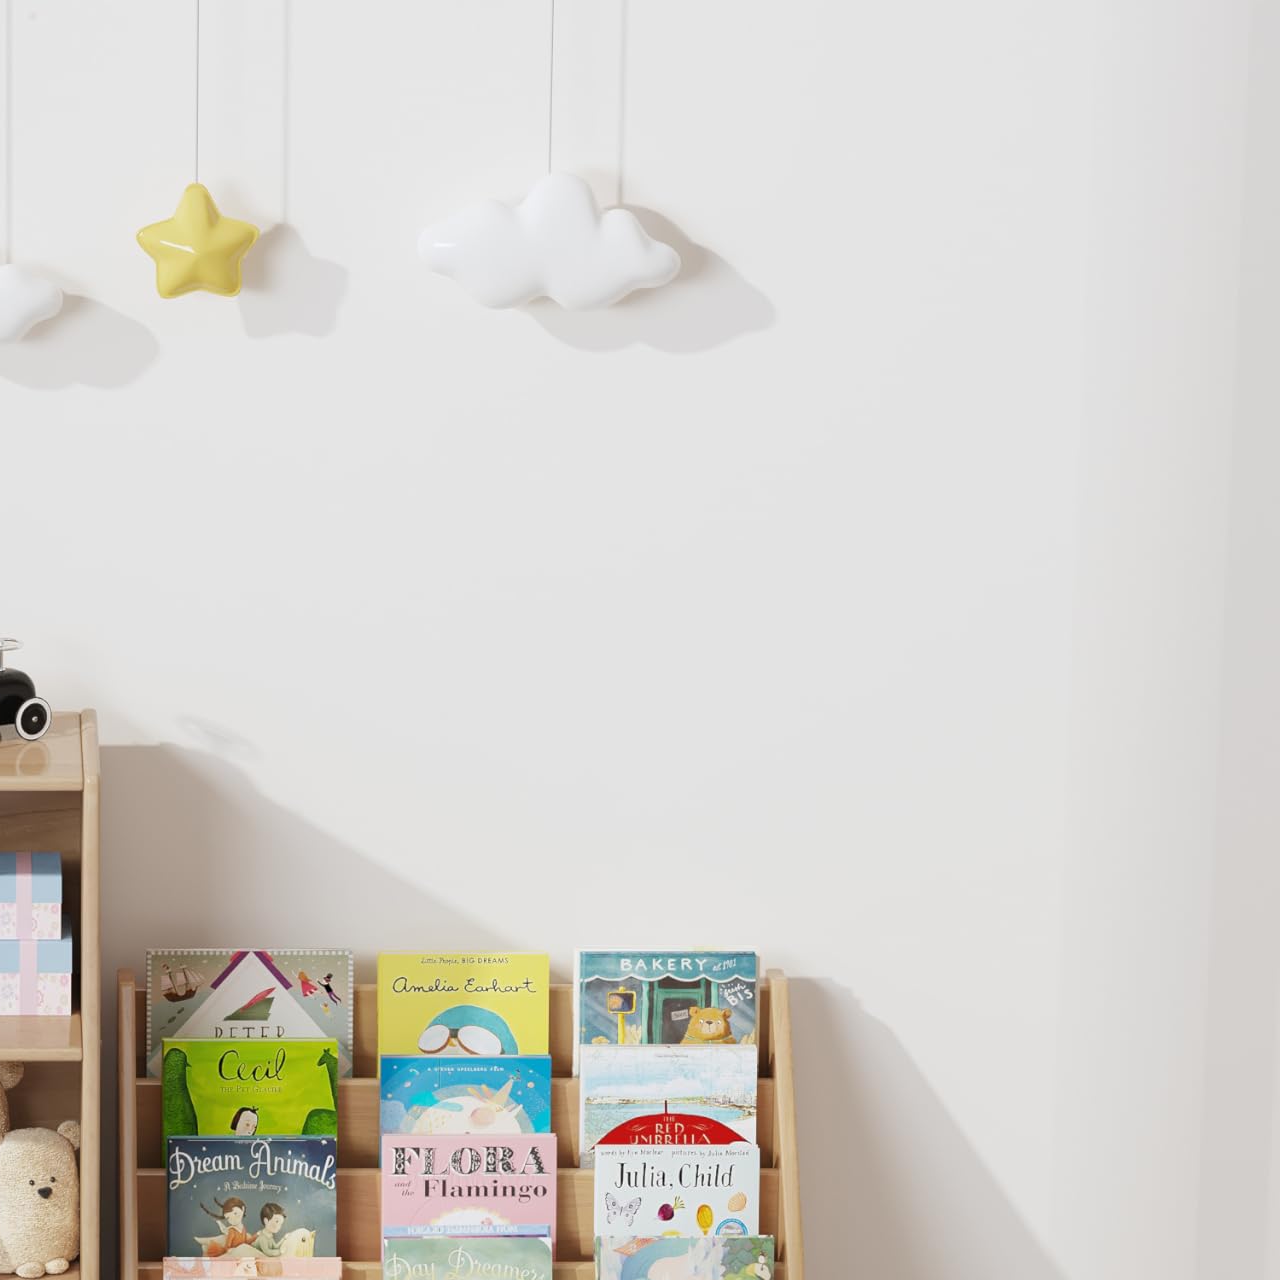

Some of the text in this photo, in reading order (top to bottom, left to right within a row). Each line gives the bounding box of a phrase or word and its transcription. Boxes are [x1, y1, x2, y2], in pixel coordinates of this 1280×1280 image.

[620, 958, 708, 971] BAKERY
[392, 976, 537, 993] Amelia Earhart
[218, 1048, 286, 1081] Cecil
[655, 1123, 685, 1134] RED
[169, 1138, 337, 1190] Dream Animals
[392, 1146, 551, 1176] FLORA
[394, 1180, 412, 1188] and
[614, 1162, 735, 1190] Julia, Child
[424, 1179, 548, 1204] Flamingo
